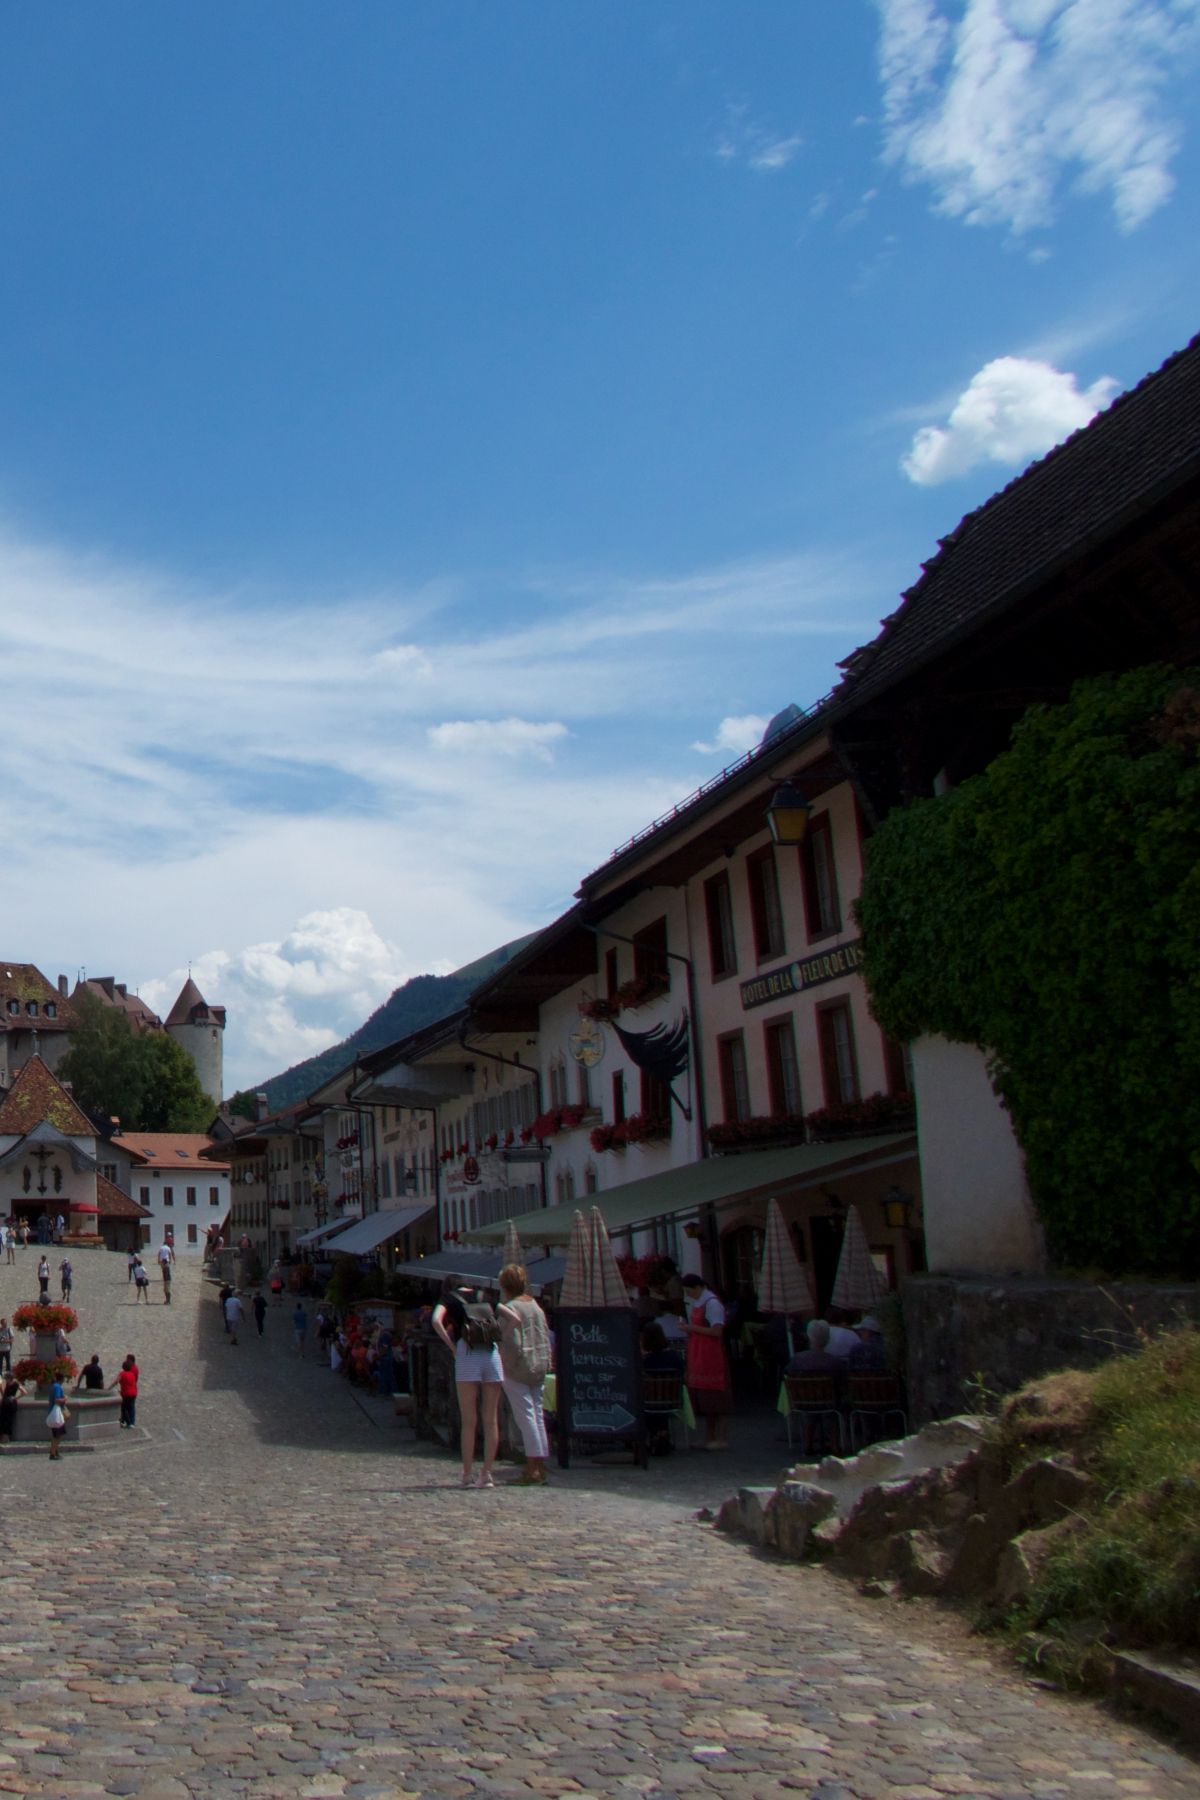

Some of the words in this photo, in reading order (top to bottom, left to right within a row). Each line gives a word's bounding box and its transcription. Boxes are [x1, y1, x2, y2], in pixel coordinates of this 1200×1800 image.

[802, 957, 834, 982] FLEUR
[570, 1323, 609, 1343] Belle
[570, 1346, 627, 1367] terrasse
